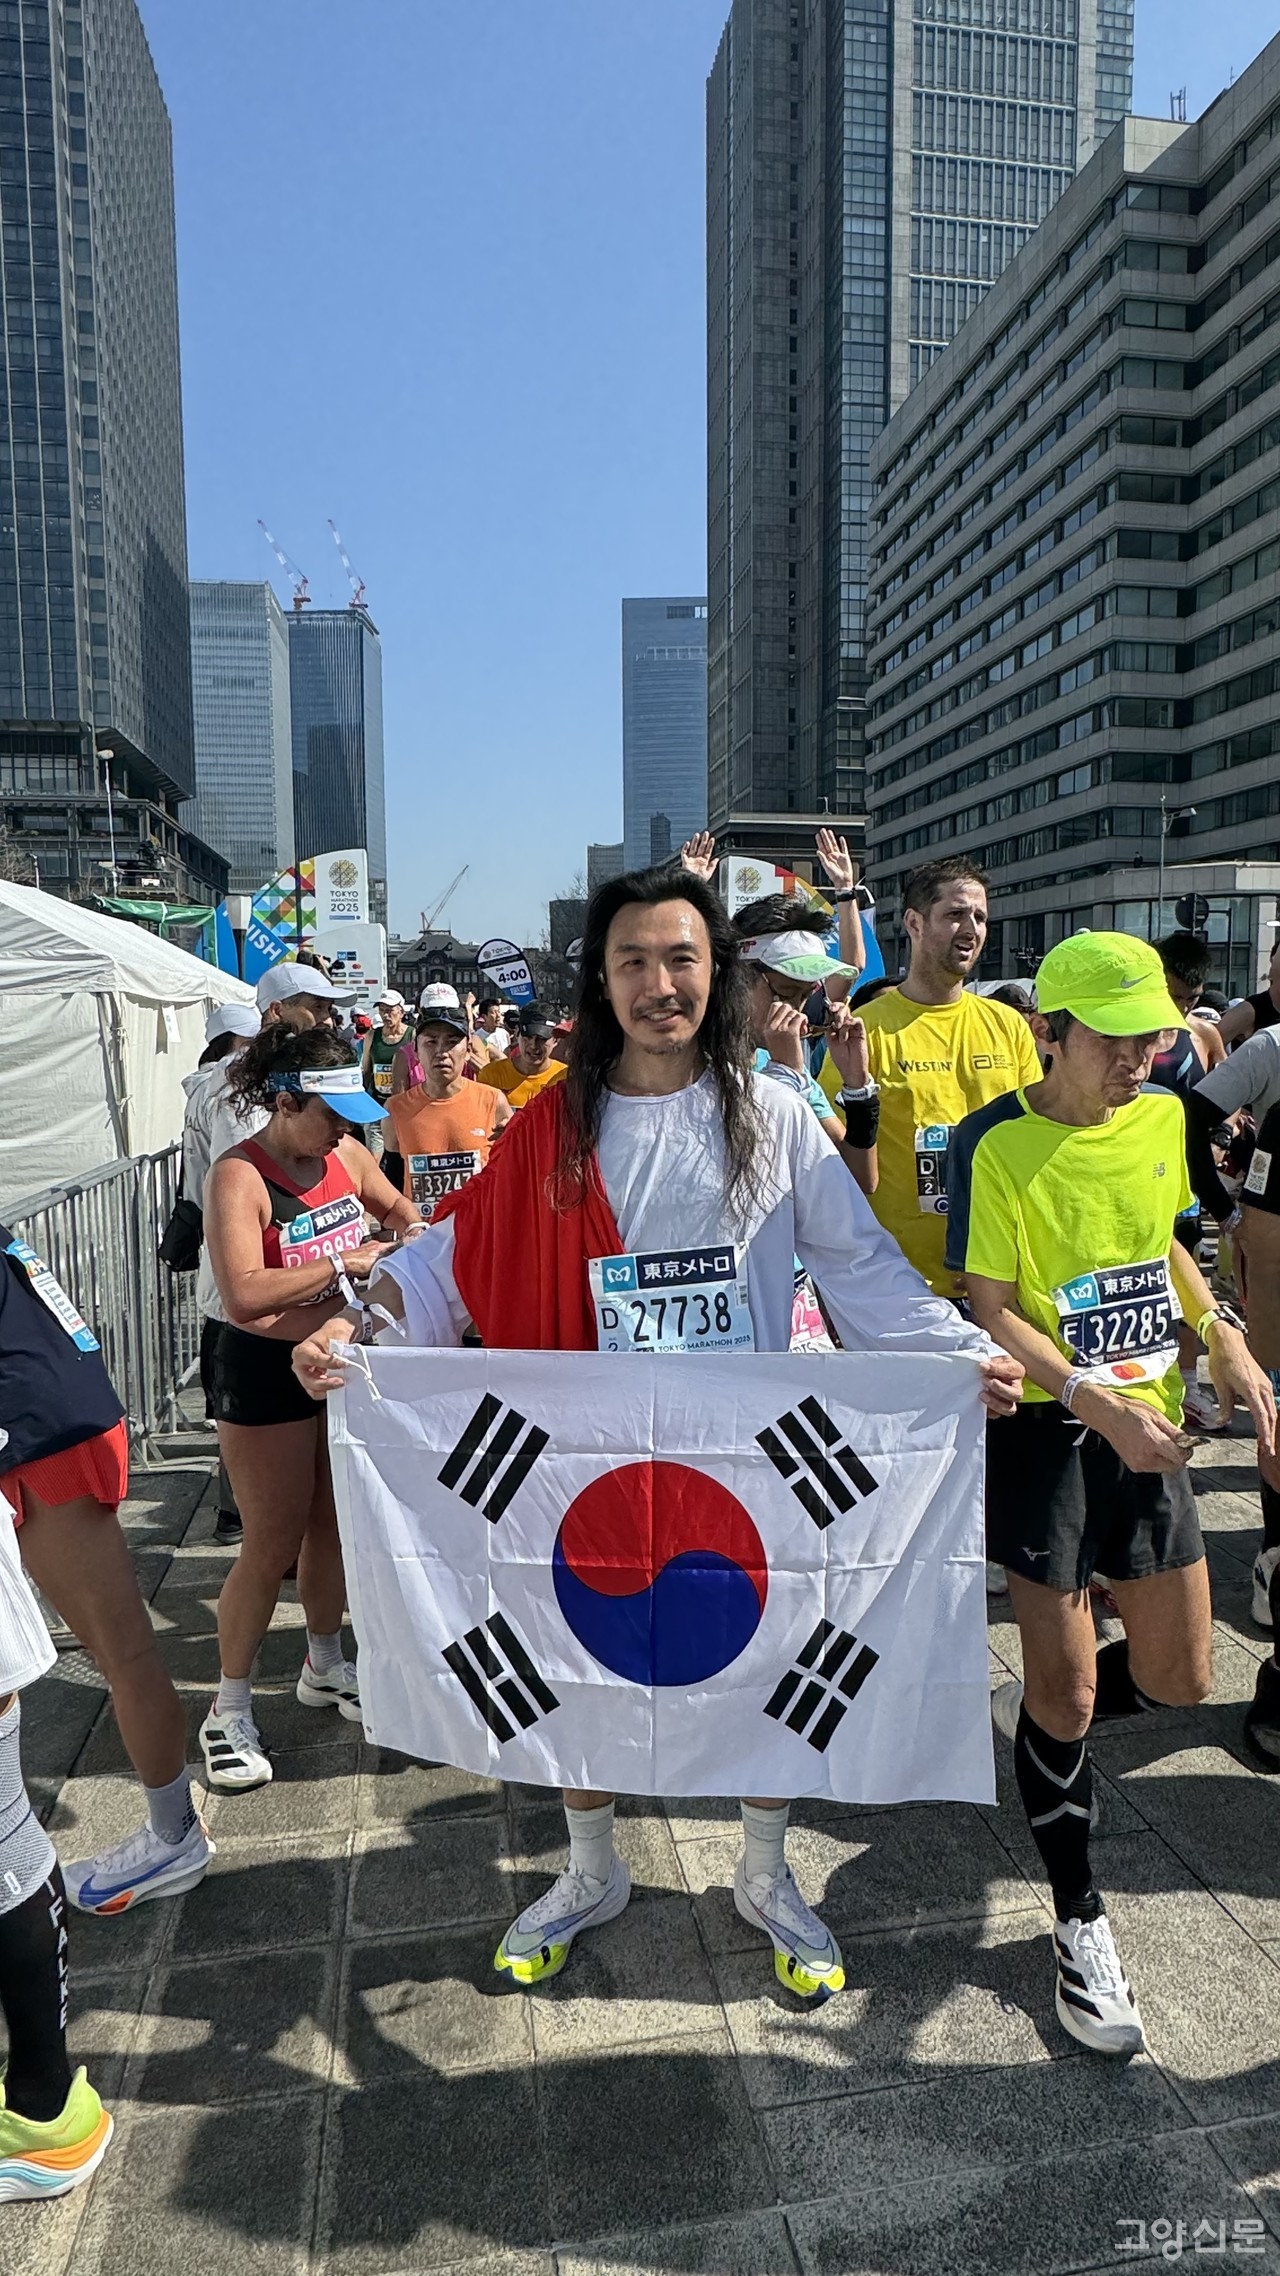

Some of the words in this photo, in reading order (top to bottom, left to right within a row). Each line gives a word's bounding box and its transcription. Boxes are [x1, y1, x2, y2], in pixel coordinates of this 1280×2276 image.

[330, 890, 359, 898] TOKYO
[330, 903, 359, 912] 2025
[498, 968, 527, 984] 4:00
[897, 1060, 952, 1074] WESTIN
[430, 1156, 472, 1168] 東京メトロ
[920, 1158, 935, 1175] D
[412, 1177, 420, 1190] F
[924, 1182, 934, 1195] 2
[643, 1255, 730, 1281] 東京メトロ
[1102, 1268, 1165, 1296] 東京メトロ
[601, 1307, 619, 1330] D
[630, 1291, 732, 1344] 27738
[1088, 1301, 1169, 1355] 32285
[658, 1343, 686, 1353] TOKYO
[687, 1338, 733, 1351] MARATHON
[734, 1334, 751, 1345] 2025
[49, 1895, 69, 2030] FALKE
